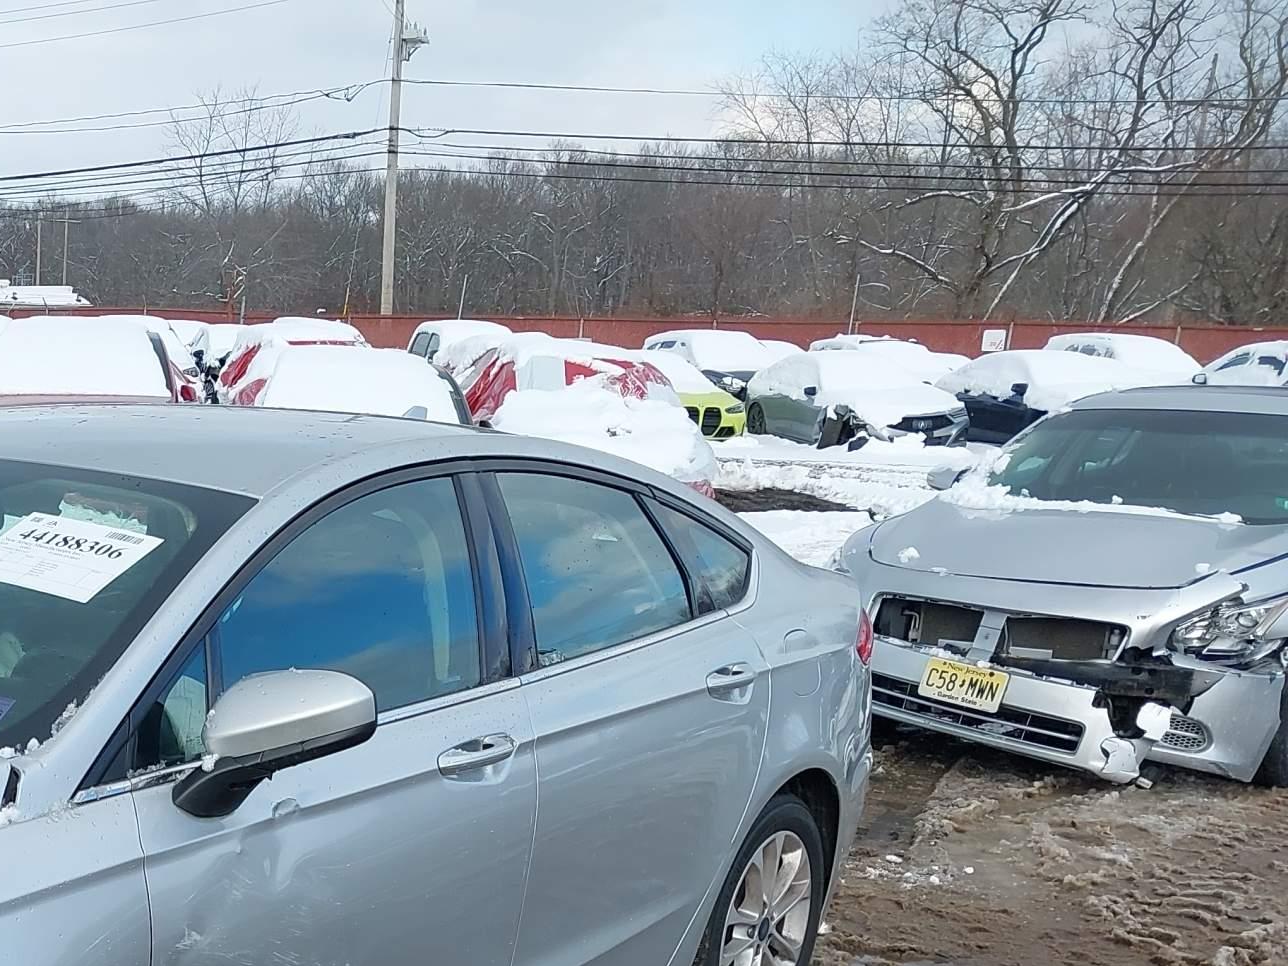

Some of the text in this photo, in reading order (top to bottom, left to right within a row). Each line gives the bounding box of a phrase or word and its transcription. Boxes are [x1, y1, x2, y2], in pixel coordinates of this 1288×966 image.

[19, 529, 126, 560] 44188306
[947, 662, 987, 679] New Jersey
[925, 667, 1000, 703] C58 MWN
[937, 691, 978, 706] Garden State
